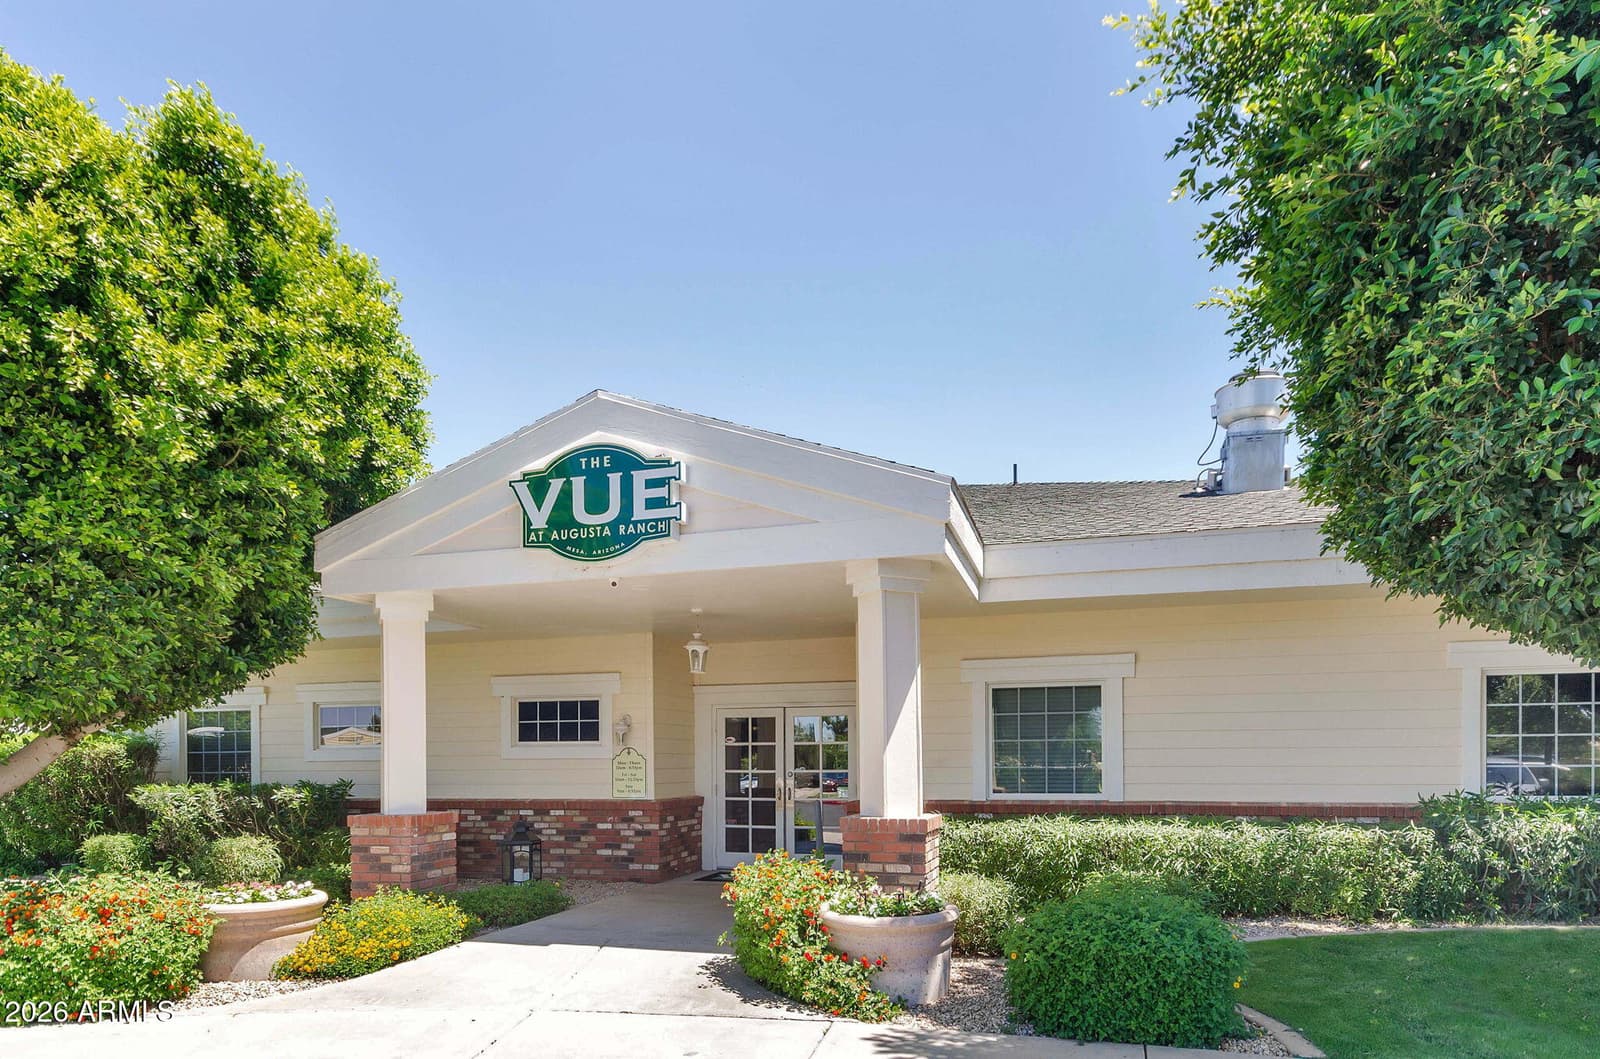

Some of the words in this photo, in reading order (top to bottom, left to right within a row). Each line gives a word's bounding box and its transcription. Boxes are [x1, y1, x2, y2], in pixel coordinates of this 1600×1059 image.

[579, 455, 611, 470] THE
[510, 463, 681, 529] VUE
[528, 531, 544, 543] AT
[551, 526, 612, 541] AUGUSTA
[618, 521, 666, 536] RANCH
[592, 542, 625, 555] ARIZONA
